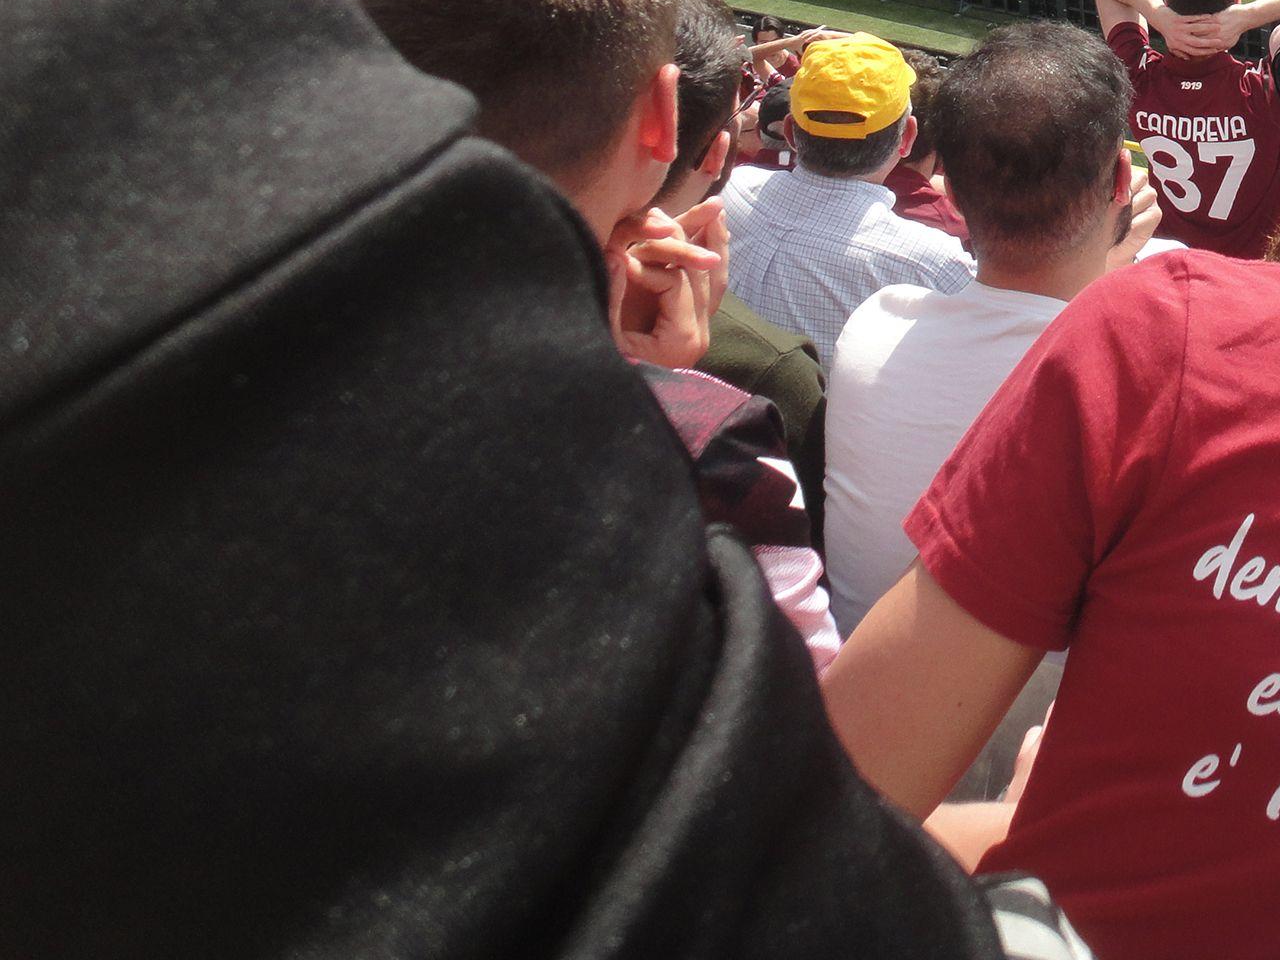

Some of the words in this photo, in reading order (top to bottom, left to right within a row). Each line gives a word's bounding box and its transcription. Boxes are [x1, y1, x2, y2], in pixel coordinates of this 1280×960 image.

[1180, 81, 1202, 90] 1919
[1136, 111, 1247, 142] CANDREVA
[1139, 135, 1255, 221] 87
[1181, 743, 1242, 798] e'
